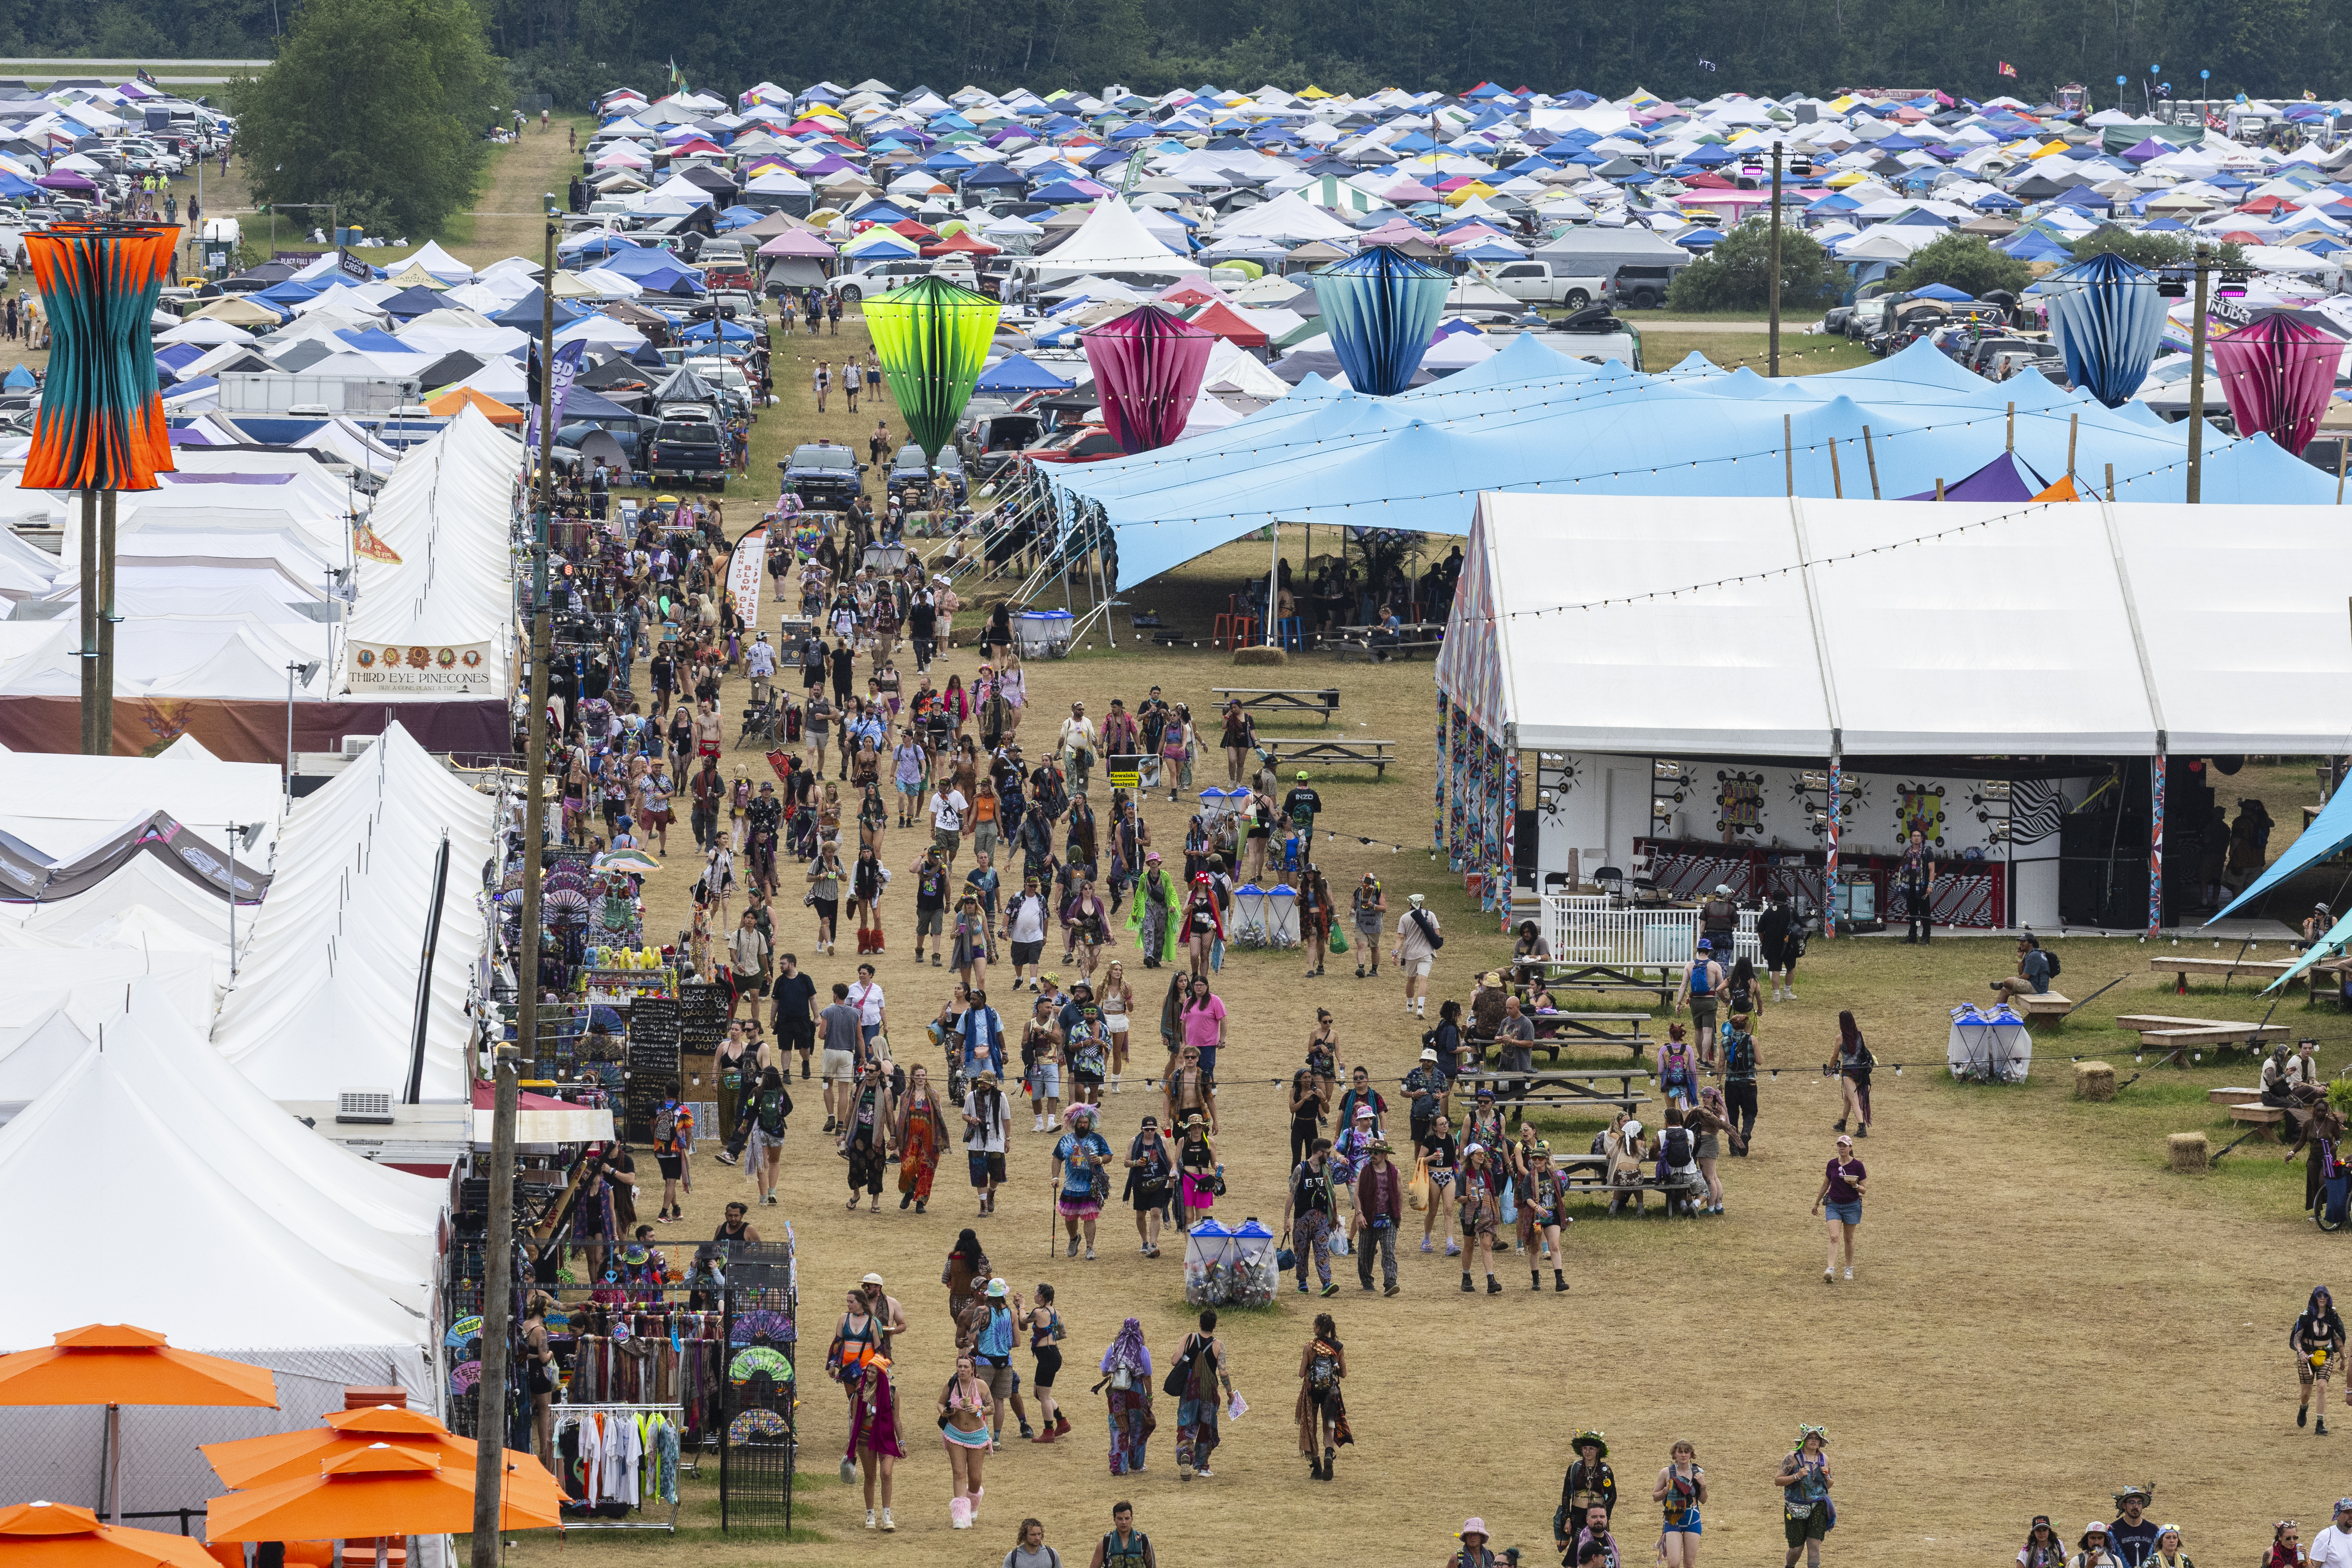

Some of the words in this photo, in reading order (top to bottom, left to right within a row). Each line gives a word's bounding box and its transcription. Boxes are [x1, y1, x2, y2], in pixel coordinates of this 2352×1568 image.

[344, 261, 365, 275] CREW
[551, 359, 574, 377] 3D
[738, 540, 747, 565] LEARN
[736, 569, 743, 578] TO
[740, 565, 752, 591] BLOW
[349, 672, 385, 683] THIRD
[389, 673, 414, 683] EYE
[419, 673, 489, 683] PINECONES
[545, 1207, 559, 1229] RAW
